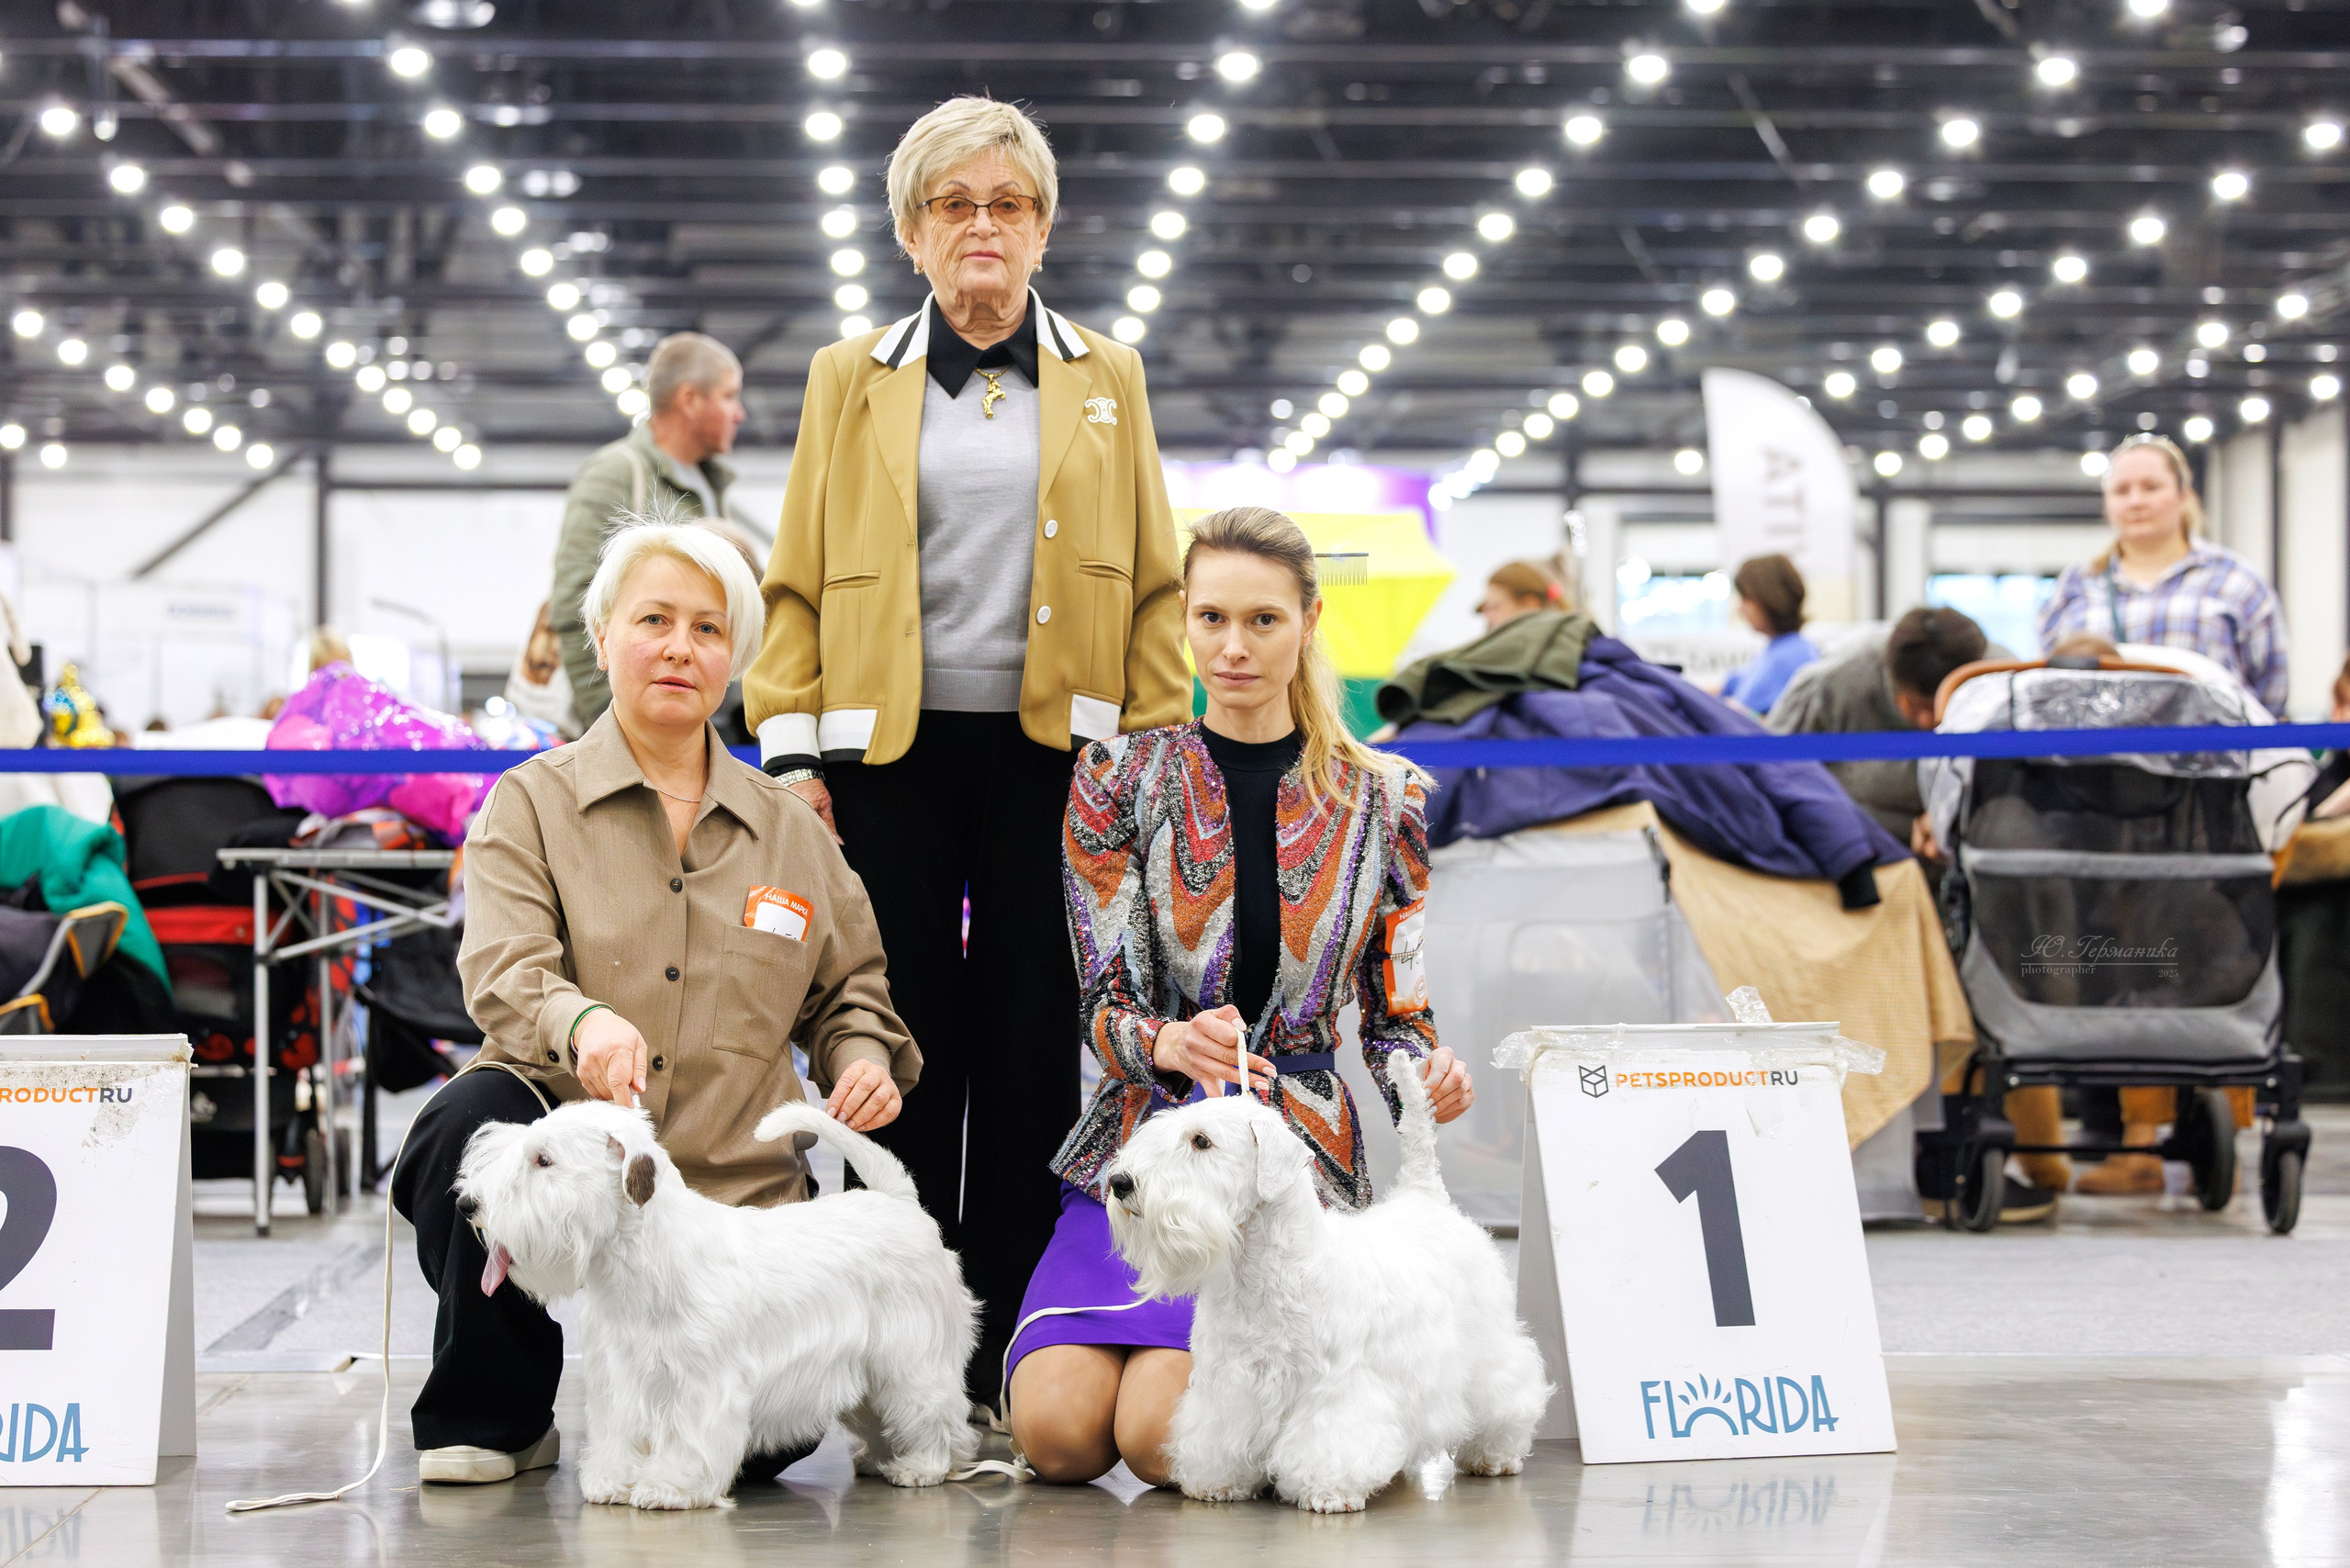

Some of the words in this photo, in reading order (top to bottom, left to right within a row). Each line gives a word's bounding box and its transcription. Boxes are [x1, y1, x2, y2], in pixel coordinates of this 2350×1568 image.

[765, 892, 789, 907] НАША
[790, 901, 809, 917] МАРКА
[1616, 1070, 1798, 1088] PETSPRODUCTRU
[1654, 1130, 1756, 1327] 1
[0, 1403, 89, 1462] IDA
[1640, 1372, 1839, 1439] FLORIDA
